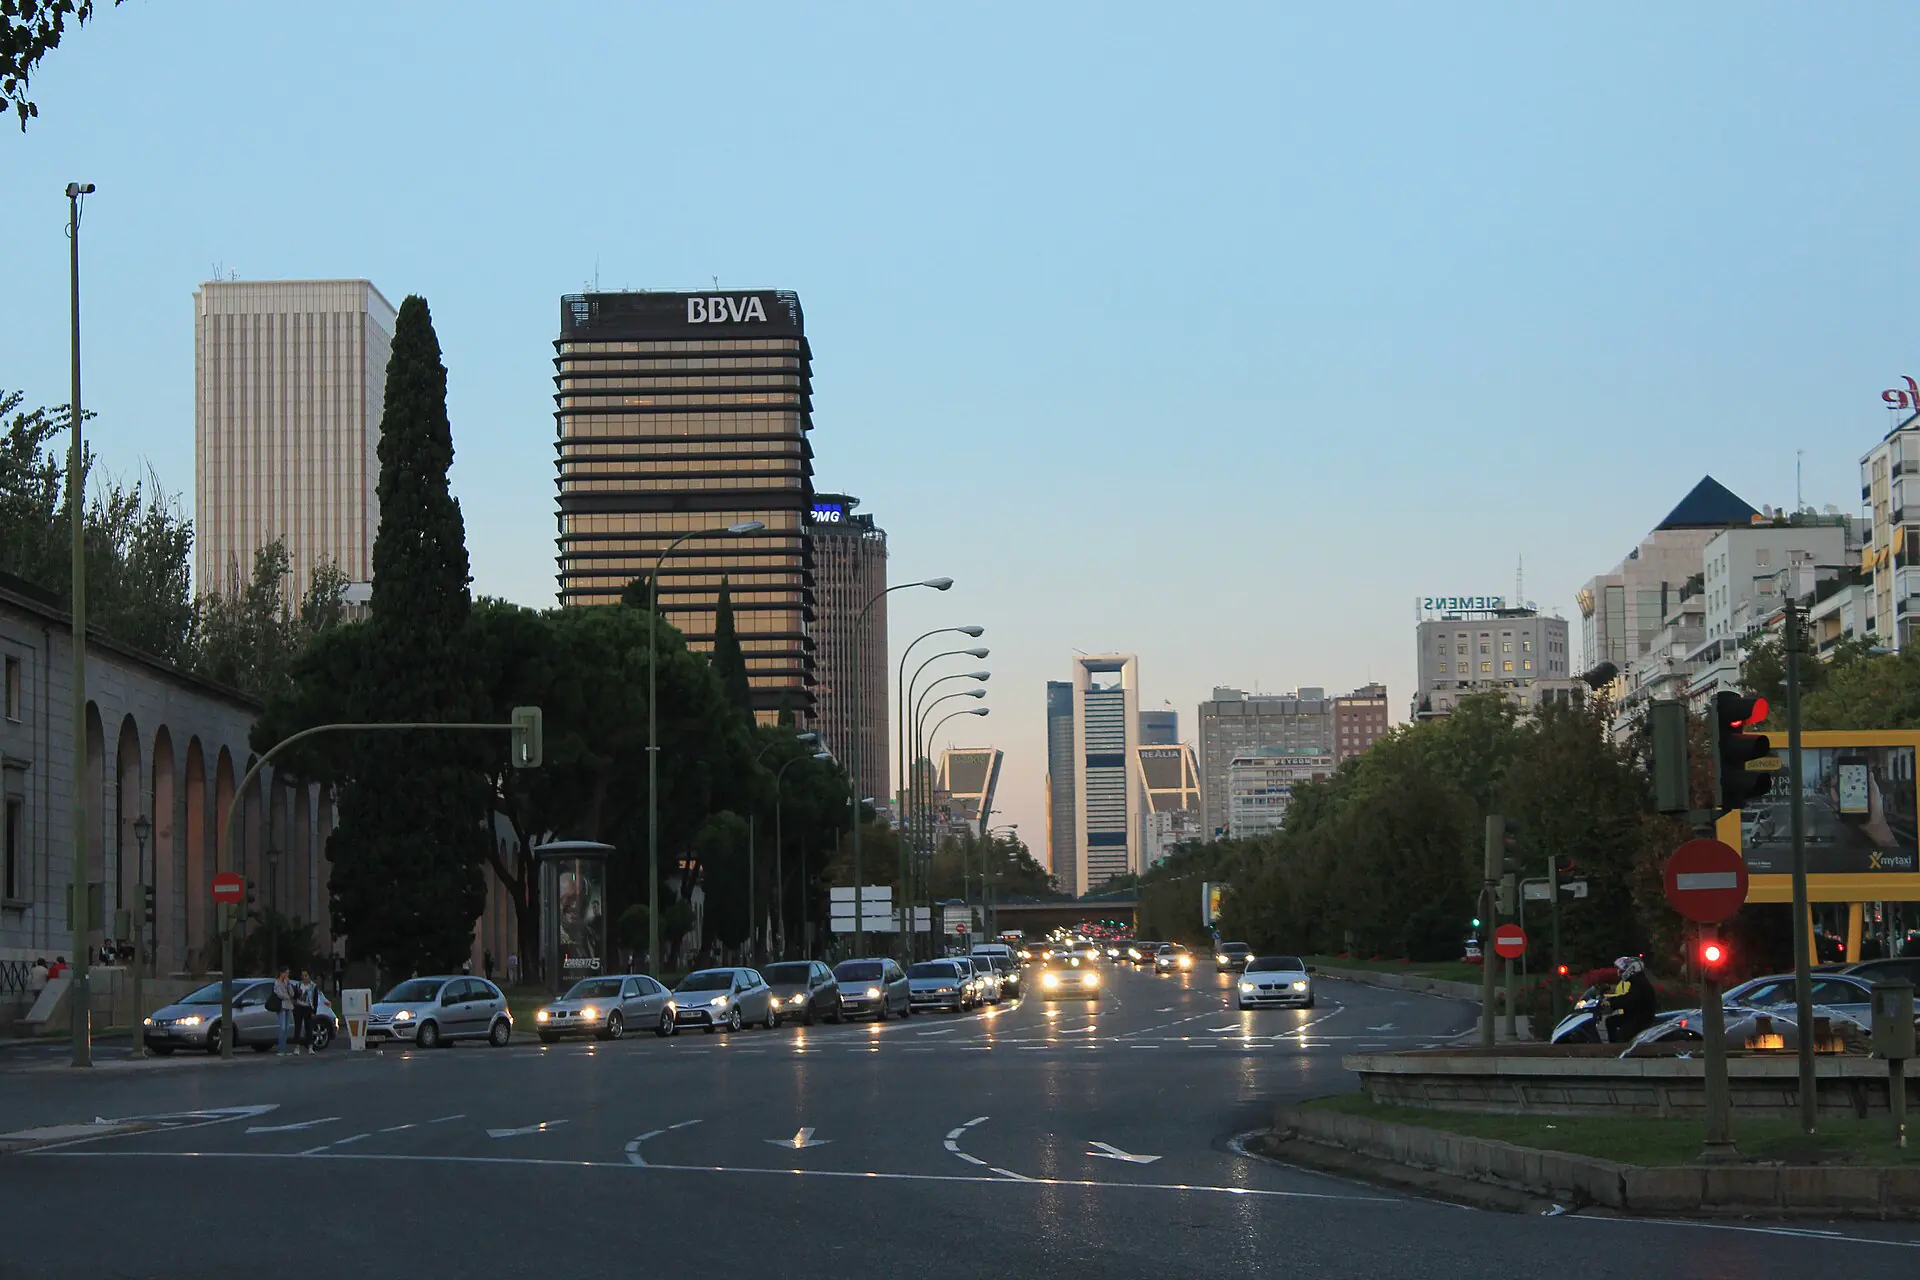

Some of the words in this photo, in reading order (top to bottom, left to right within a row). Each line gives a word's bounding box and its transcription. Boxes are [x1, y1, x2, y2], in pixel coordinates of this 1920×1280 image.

[687, 296, 768, 323] BBVA
[810, 510, 840, 522] PMG
[1141, 750, 1179, 758] REALIA
[1880, 855, 1912, 867] mytaxi
